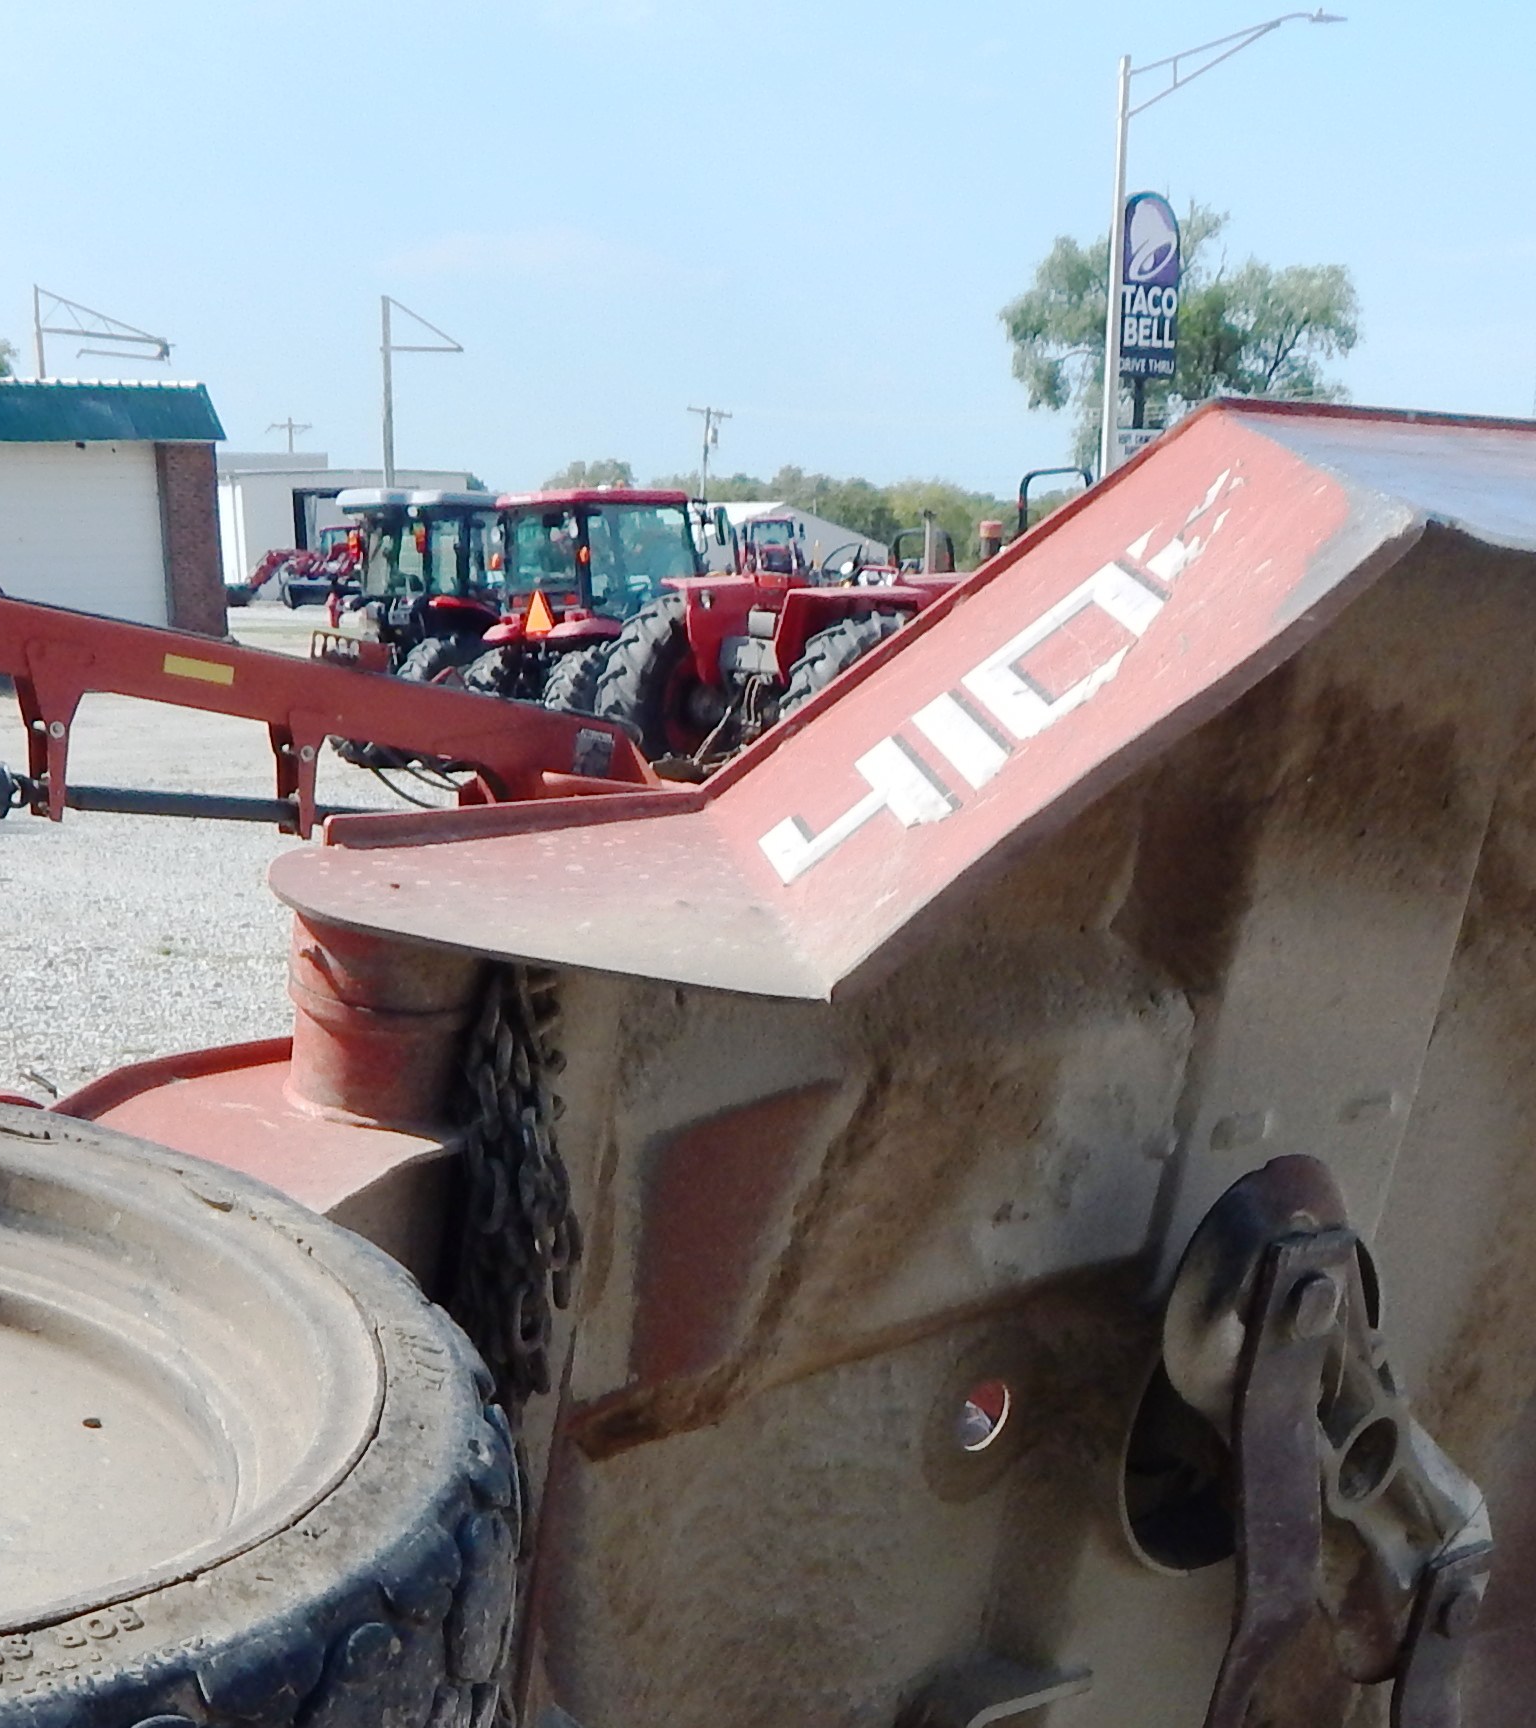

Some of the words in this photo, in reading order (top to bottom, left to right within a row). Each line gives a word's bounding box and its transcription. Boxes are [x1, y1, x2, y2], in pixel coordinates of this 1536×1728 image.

[1122, 285, 1178, 318] TACO
[1123, 316, 1176, 349] BELL
[1119, 357, 1146, 374] DRIVE
[1148, 358, 1175, 375] THRU
[52, 1604, 146, 1650] FOR
